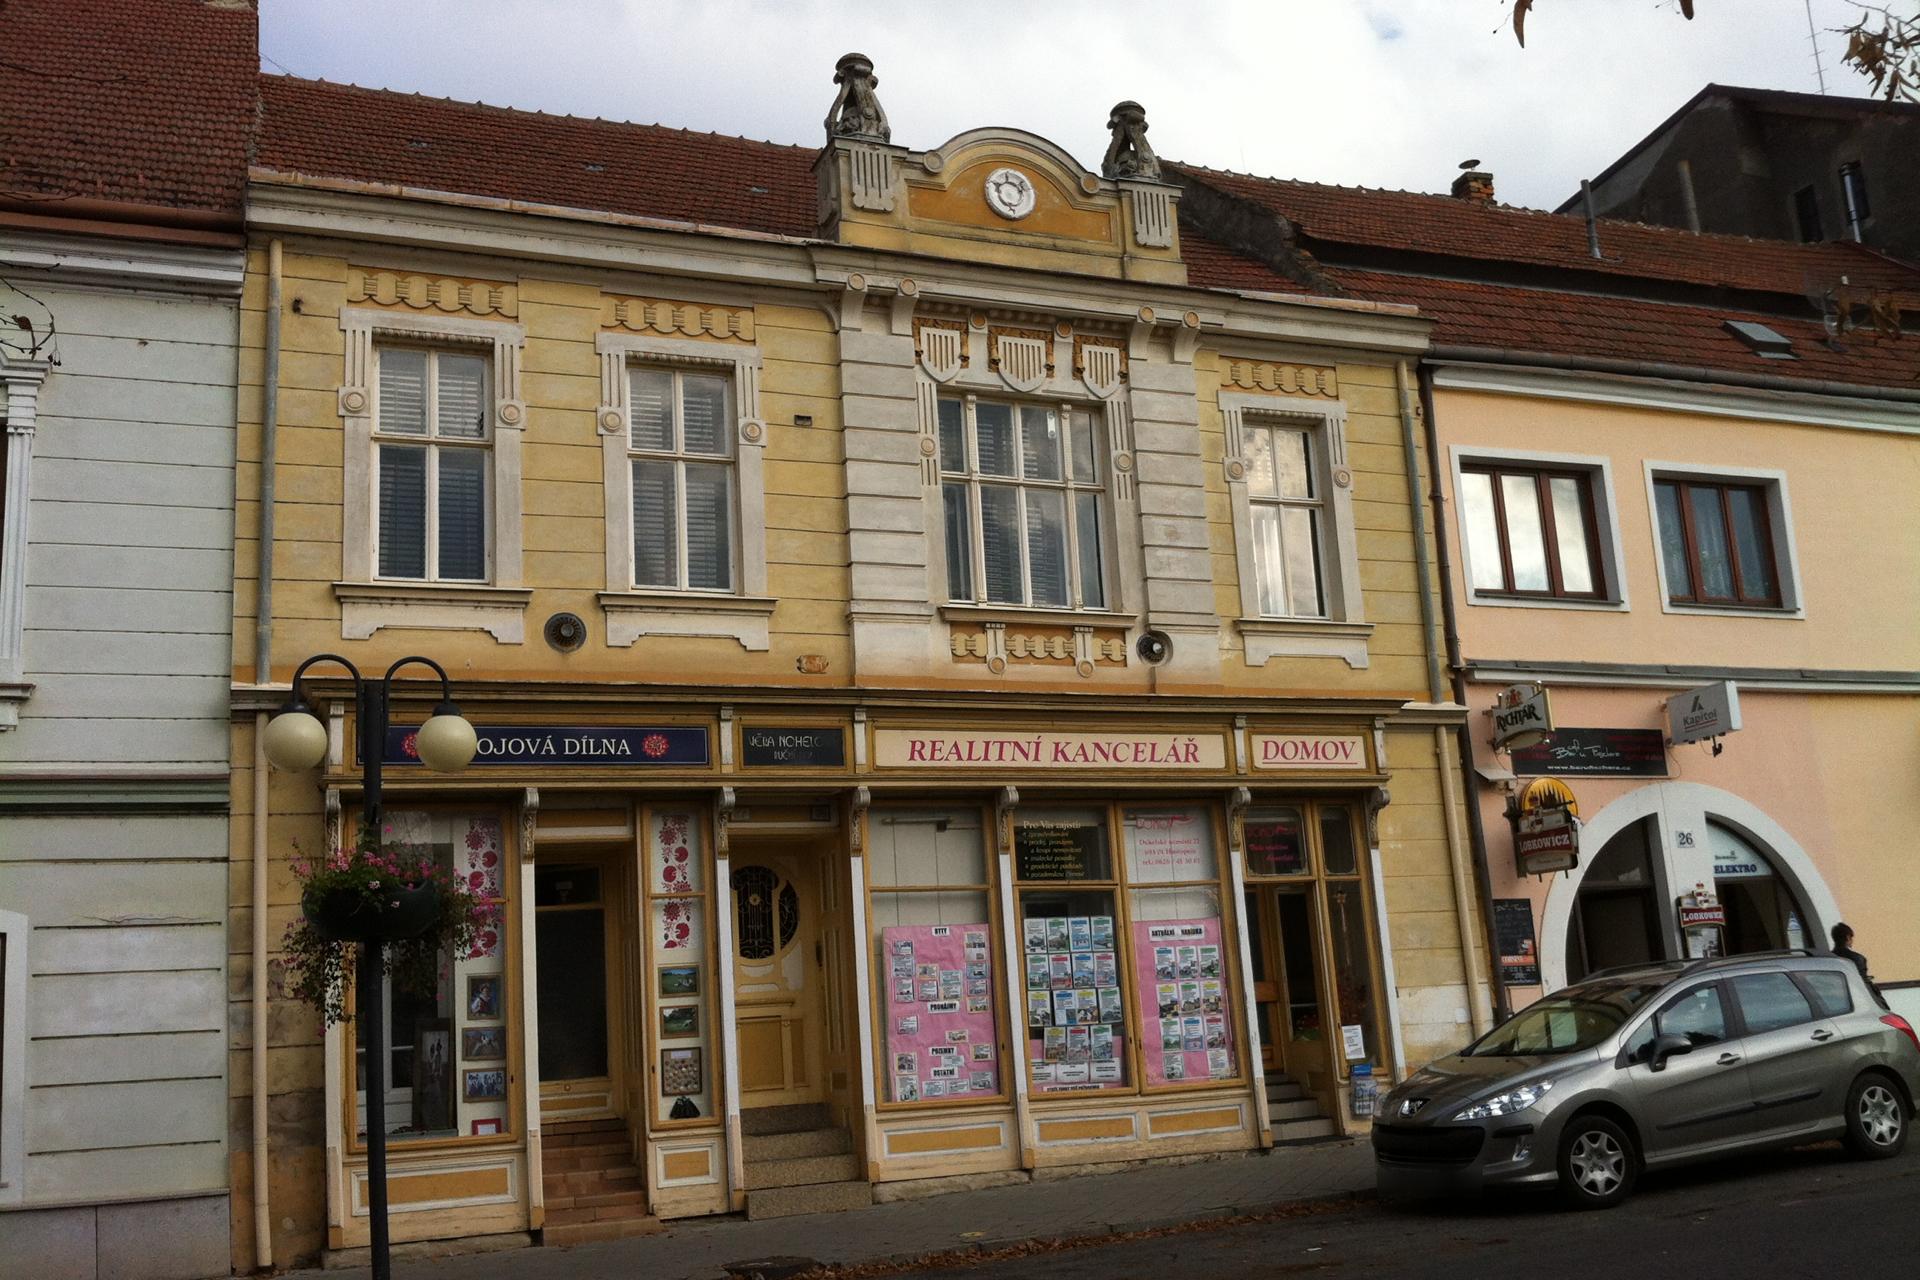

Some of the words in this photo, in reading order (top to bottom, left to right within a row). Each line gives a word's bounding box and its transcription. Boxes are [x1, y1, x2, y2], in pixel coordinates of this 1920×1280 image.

[1683, 708, 1718, 726] Kapitol
[476, 735, 557, 756] OJOVÁ
[563, 735, 632, 756] DÍLNA
[907, 735, 1041, 762] REALITNÍ
[1051, 737, 1201, 764] KANCELÁŘ
[1262, 740, 1357, 762] DOMOV
[1519, 834, 1570, 853] LOBKOWICZ
[1678, 832, 1693, 845] 26
[1713, 864, 1757, 874] ELEKTRO
